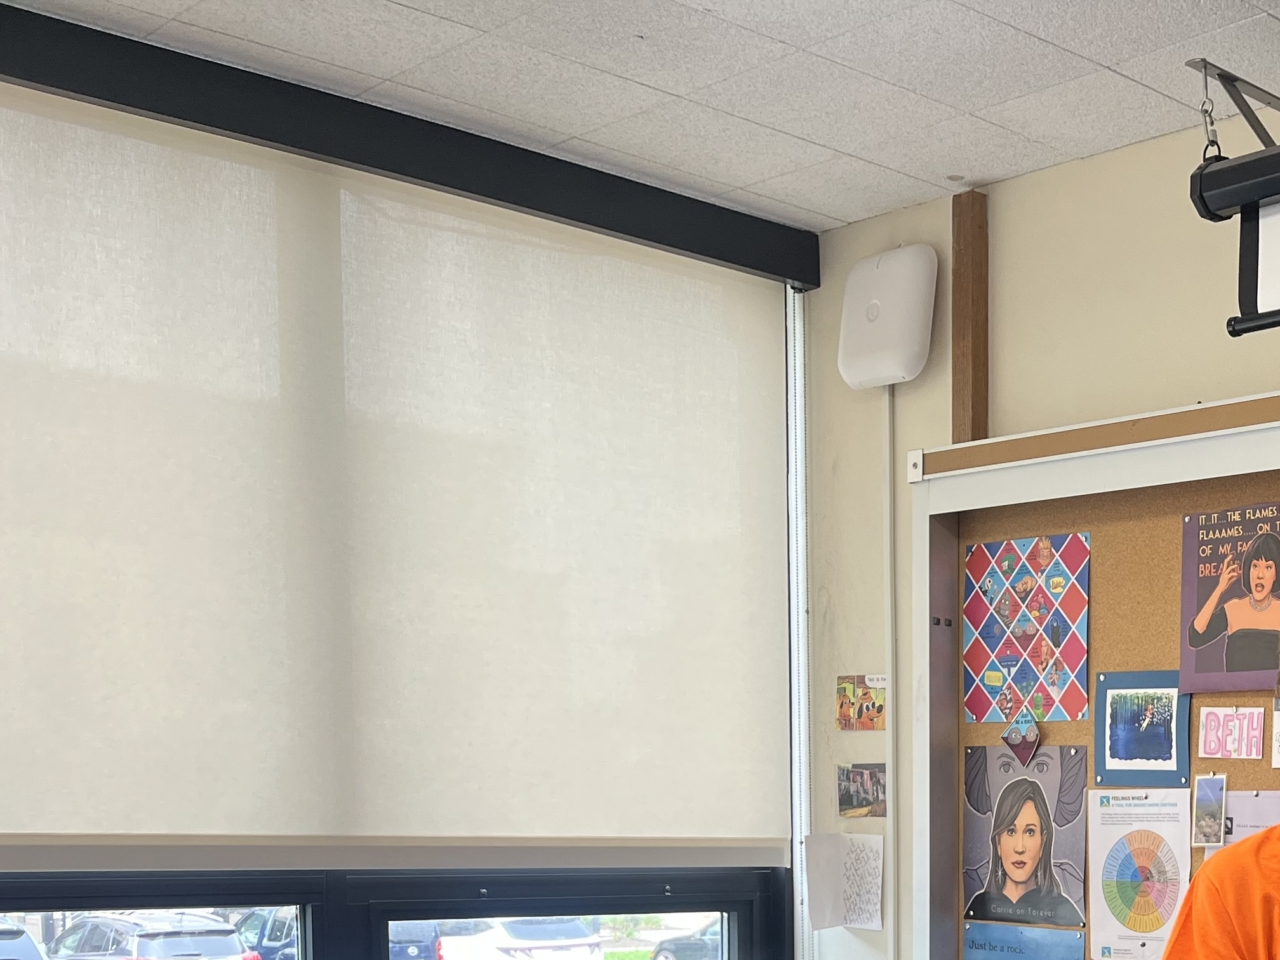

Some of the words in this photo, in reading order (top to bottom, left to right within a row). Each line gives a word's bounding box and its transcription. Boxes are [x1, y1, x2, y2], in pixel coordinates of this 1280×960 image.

[1227, 511, 1241, 522] THE
[1257, 523, 1270, 534] ON
[1199, 545, 1213, 557] OF
[1218, 543, 1232, 555] MY
[1203, 711, 1264, 758] BETH
[991, 904, 1013, 914] Carrie
[1016, 907, 1025, 915] on
[968, 940, 987, 951] Just
[989, 942, 998, 952] be
[1007, 944, 1026, 955] rock.
